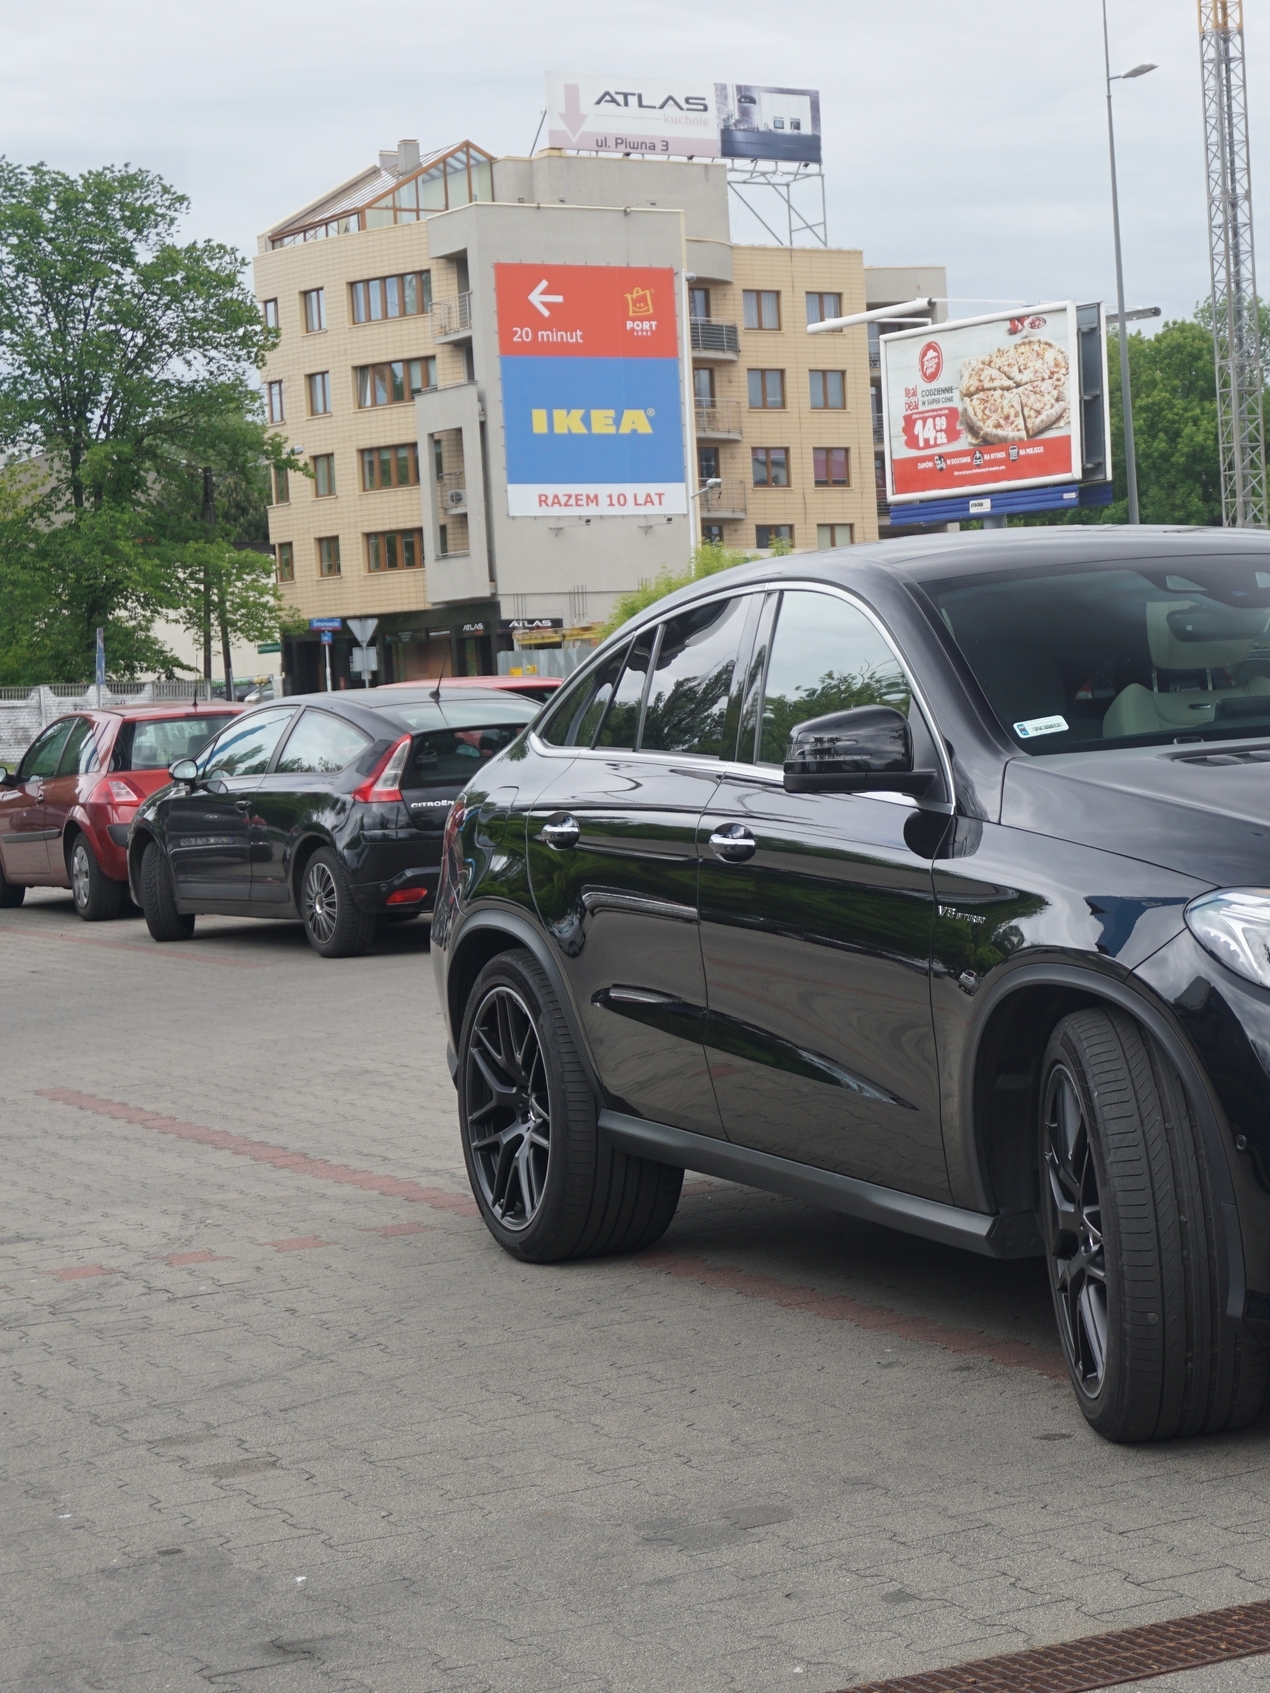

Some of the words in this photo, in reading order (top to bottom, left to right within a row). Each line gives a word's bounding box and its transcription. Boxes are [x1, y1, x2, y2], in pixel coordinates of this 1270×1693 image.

[594, 90, 708, 113] ATLAS
[663, 113, 710, 127] kuchnie
[595, 137, 611, 149] ul.
[615, 137, 656, 151] Piwna
[660, 140, 670, 152] 3
[626, 320, 658, 331] PORT
[512, 327, 532, 342] 20
[538, 328, 584, 343] minut
[921, 386, 954, 398] CODZIENNIE
[927, 398, 941, 406] SUPER
[941, 396, 954, 404] CENIE
[531, 408, 654, 434] IKEA
[913, 417, 936, 447] 14
[935, 416, 947, 430] 99
[991, 451, 1006, 459] WYNOS
[1026, 446, 1044, 454] MIEJSCU
[538, 493, 600, 507] RAZEM
[606, 493, 627, 507] 10
[633, 492, 666, 506] LAT
[463, 622, 484, 632] ATLAS
[509, 619, 552, 628] ATLAS
[410, 800, 454, 808] CITROËN
